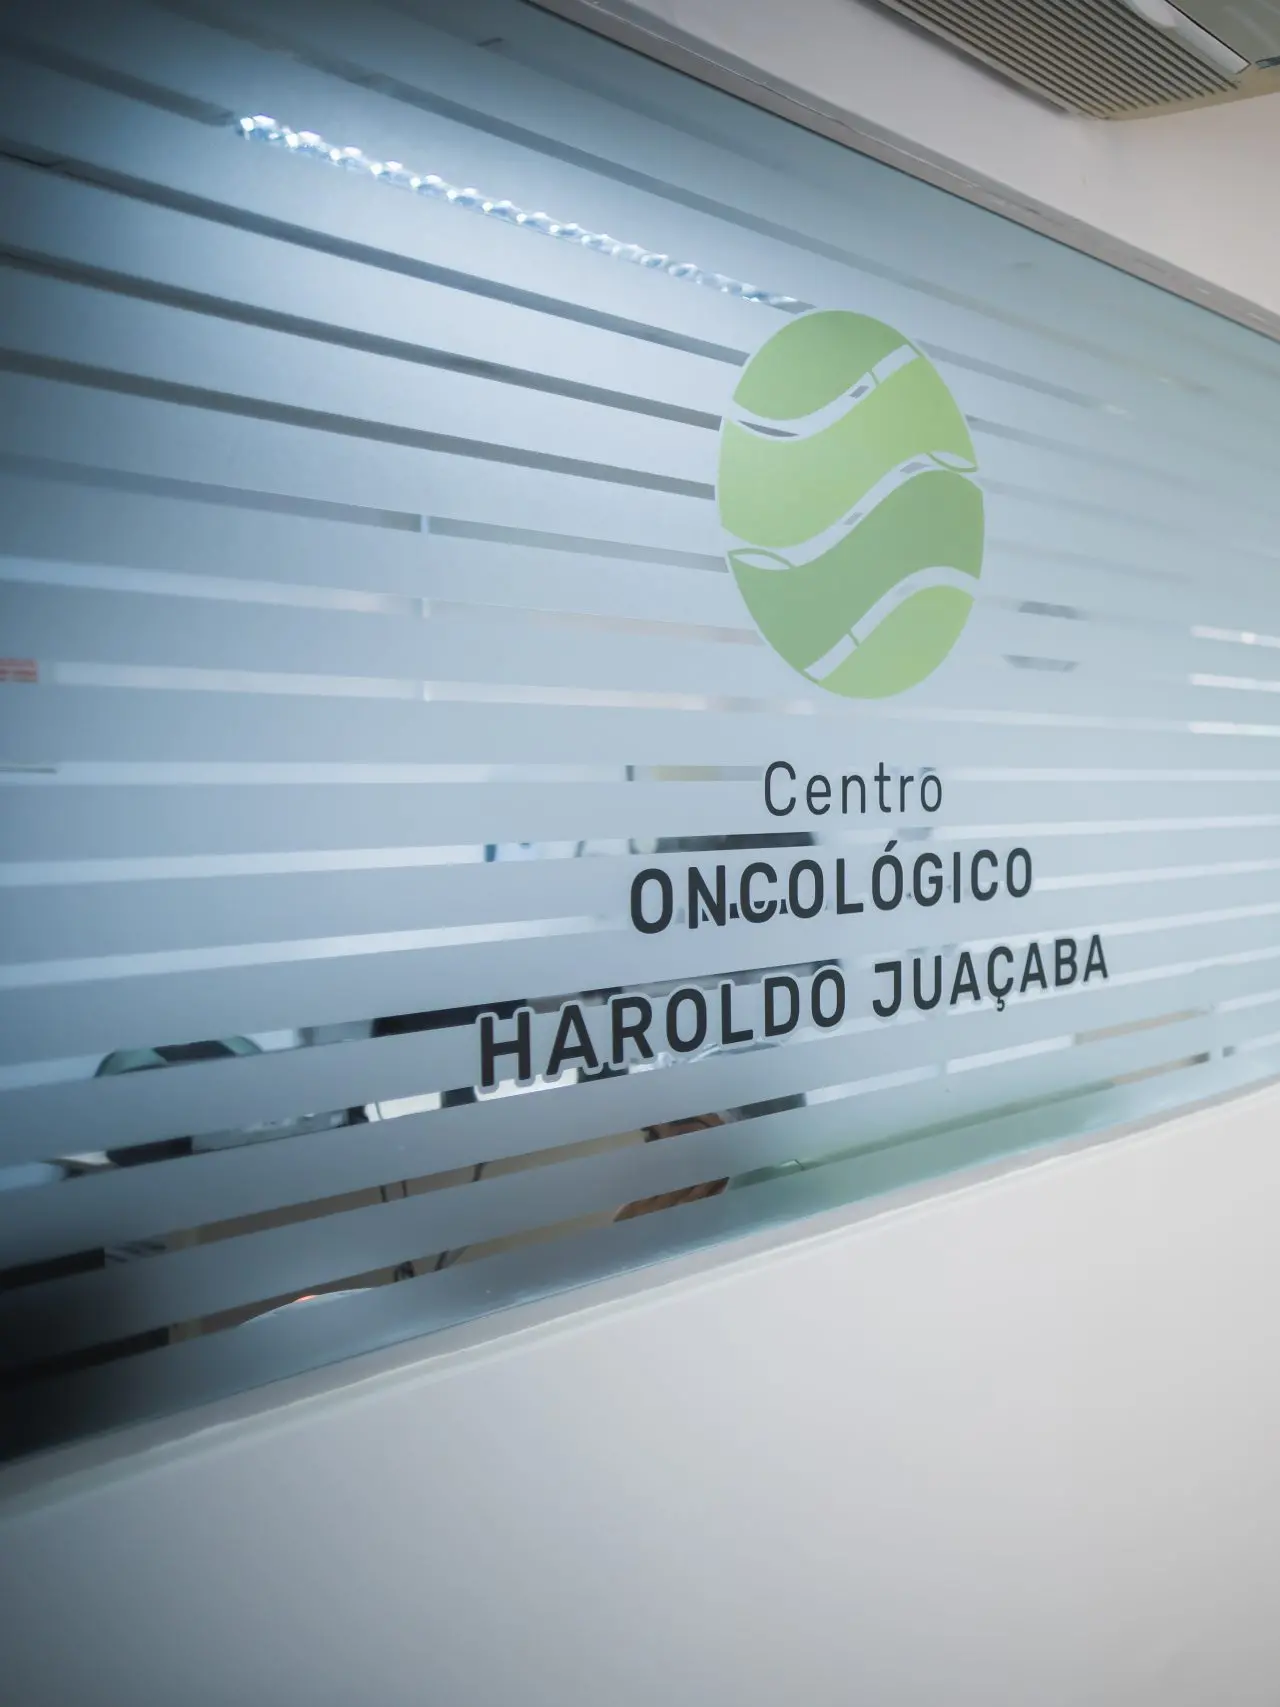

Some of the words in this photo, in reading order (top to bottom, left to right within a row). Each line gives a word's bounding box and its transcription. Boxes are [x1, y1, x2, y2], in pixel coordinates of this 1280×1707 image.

[764, 760, 943, 816] Centro
[630, 840, 1033, 934] ONCOLÓGICO
[480, 968, 846, 1087] HAROLDO
[872, 933, 1109, 1017] JUAÇABA
